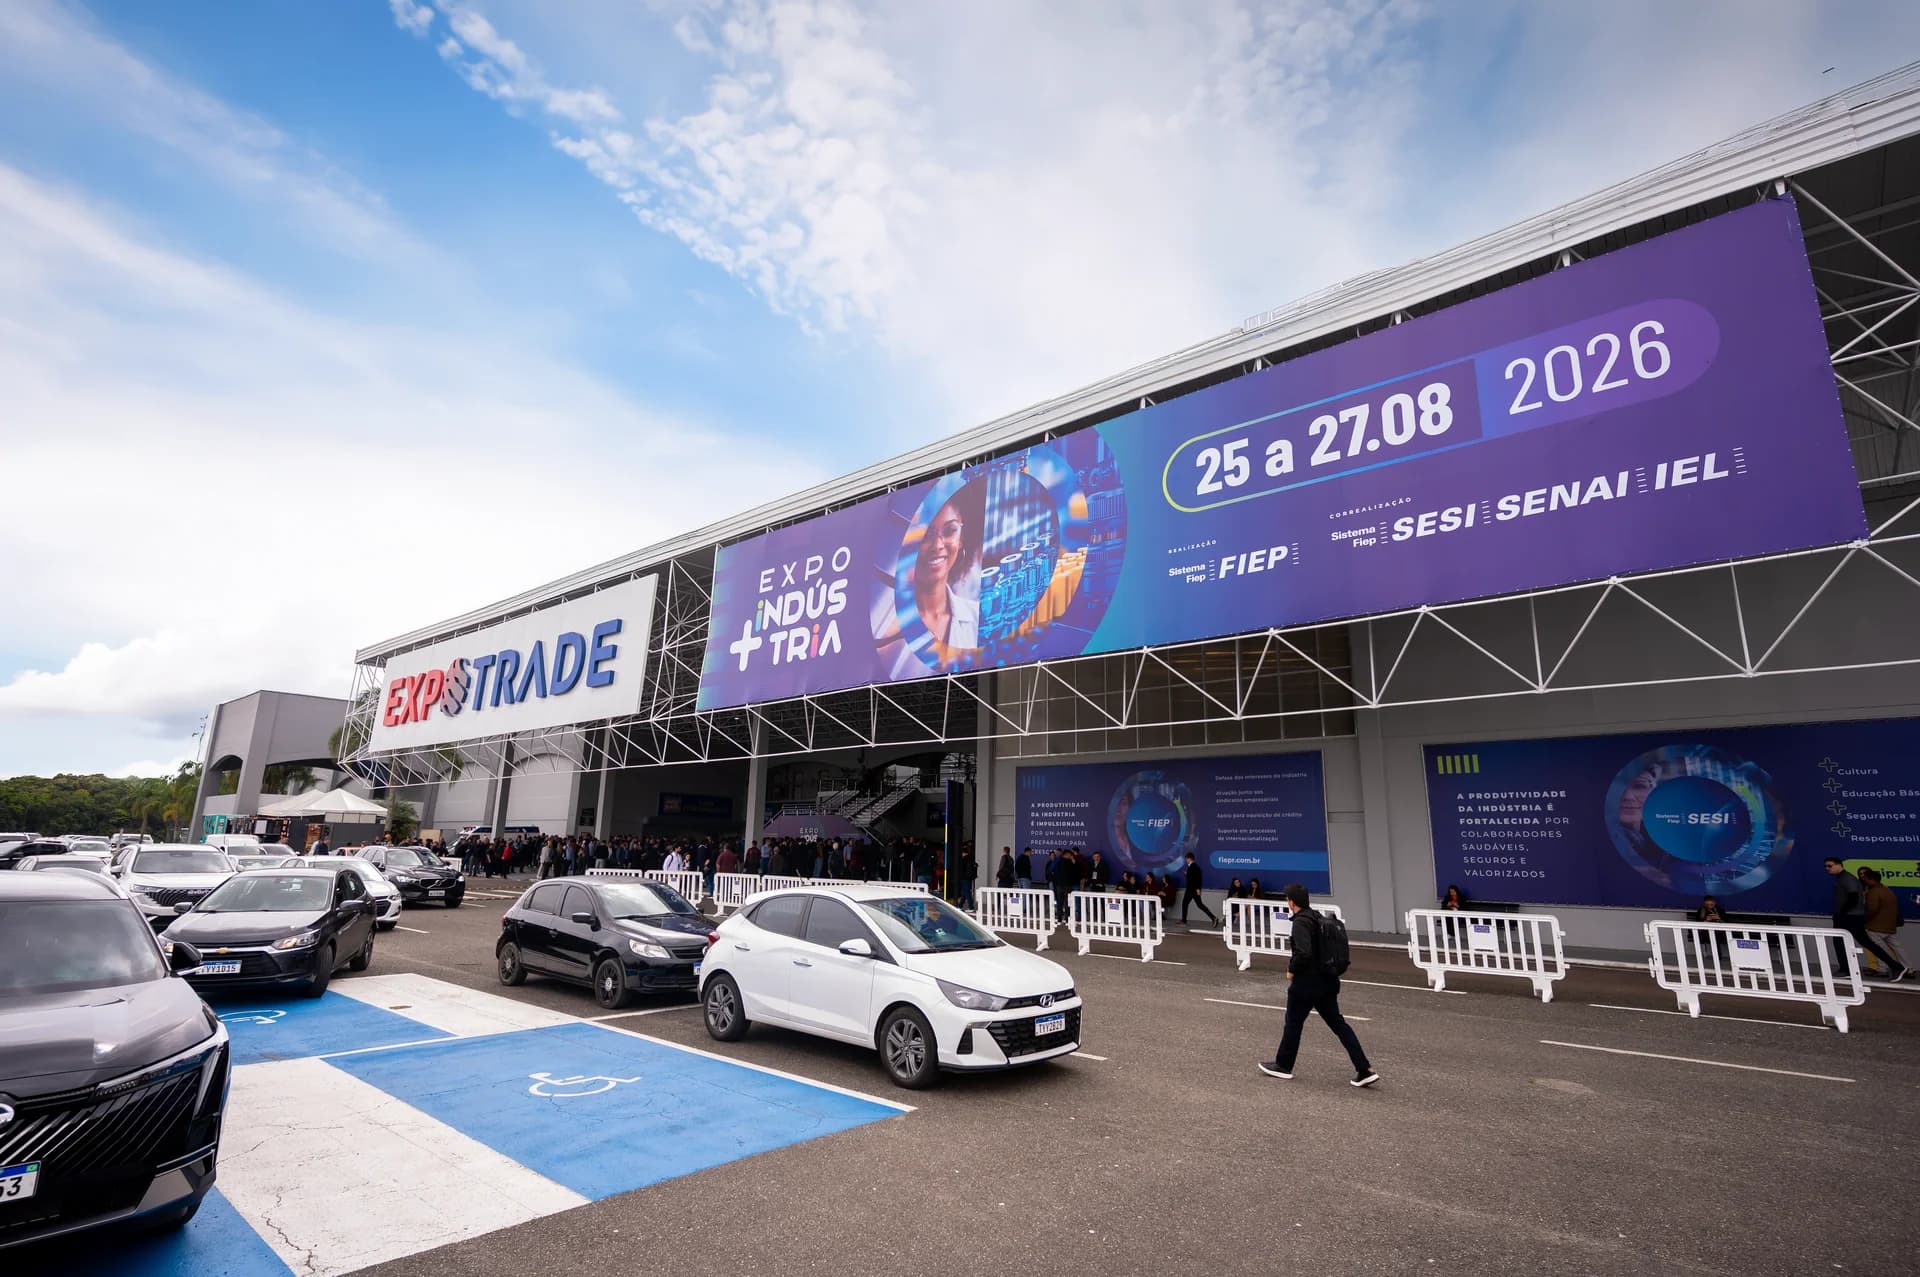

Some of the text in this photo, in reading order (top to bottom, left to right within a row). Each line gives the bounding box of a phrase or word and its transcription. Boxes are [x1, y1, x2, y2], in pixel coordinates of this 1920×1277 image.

[1505, 320, 1671, 415] 2026
[1196, 382, 1453, 495] 25 a 27.08
[1391, 452, 1729, 542] SESI SENAI IEL
[1329, 497, 1412, 519] CORREALIZAÇÃO
[1331, 526, 1376, 541] Sistema
[1168, 539, 1217, 554] REALIZAÇÃO
[1352, 537, 1377, 548] Fiep
[1219, 545, 1288, 579] FIEP
[759, 546, 851, 594] EXPO
[1168, 564, 1206, 576] Sistema
[1186, 574, 1206, 583] Fiep
[1469, 791, 1566, 799] PRODUTIVIDADE
[1842, 789, 1896, 798] Educação
[1478, 804, 1541, 812] INDÚSTRIA
[1548, 803, 1554, 811] É
[1687, 813, 1729, 824] SESI
[1846, 812, 1906, 820] Segurança
[1147, 818, 1170, 827] FIEP
[1462, 843, 1529, 851] SAUDÁVEIS,
[1465, 870, 1545, 878] VALORIZADOS
